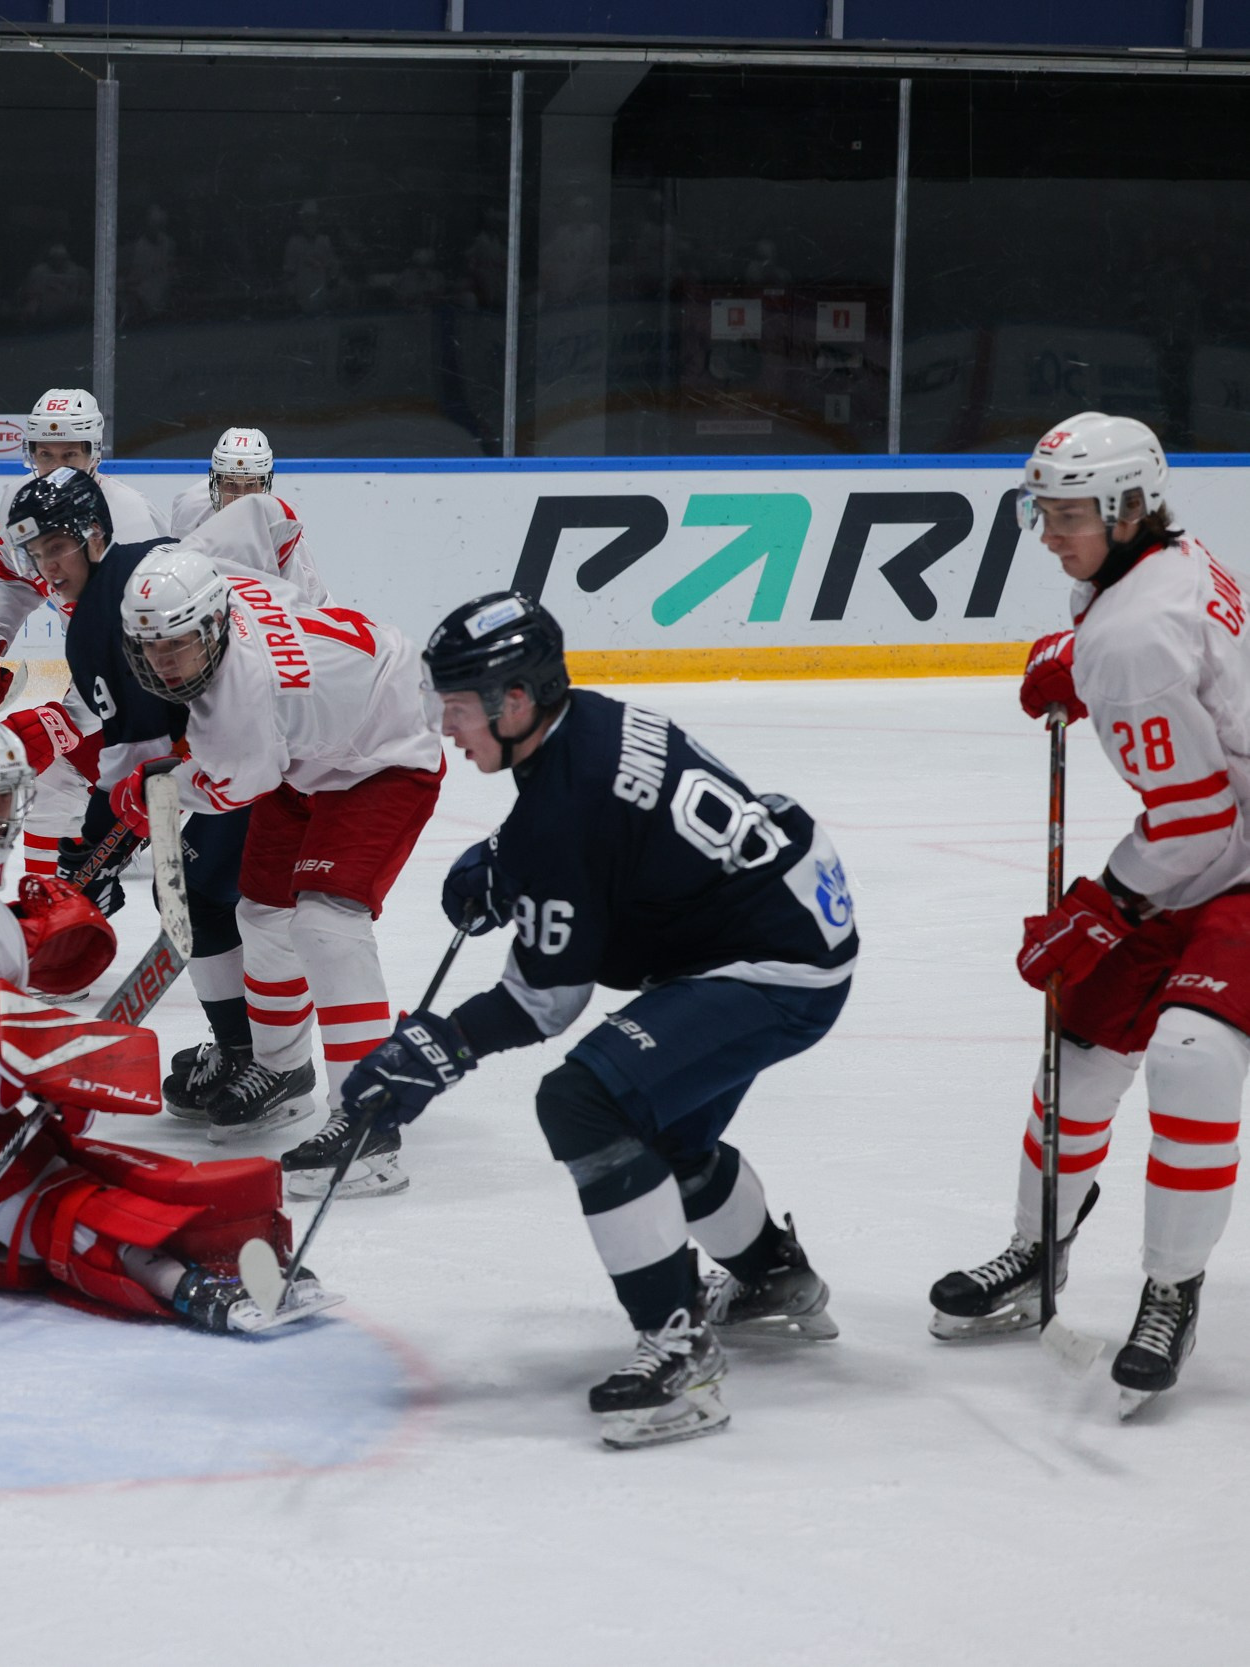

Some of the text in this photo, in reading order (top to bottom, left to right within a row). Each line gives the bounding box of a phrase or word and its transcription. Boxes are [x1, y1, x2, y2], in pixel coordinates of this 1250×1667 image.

[46, 399, 68, 411] 62
[234, 436, 248, 447] 71
[510, 491, 1030, 627] PARI
[139, 579, 152, 599] 4
[226, 576, 311, 689] KHRAPOV
[296, 607, 377, 658] 4
[93, 676, 117, 721] 9
[1112, 716, 1175, 776] 28
[512, 894, 575, 955] 86
